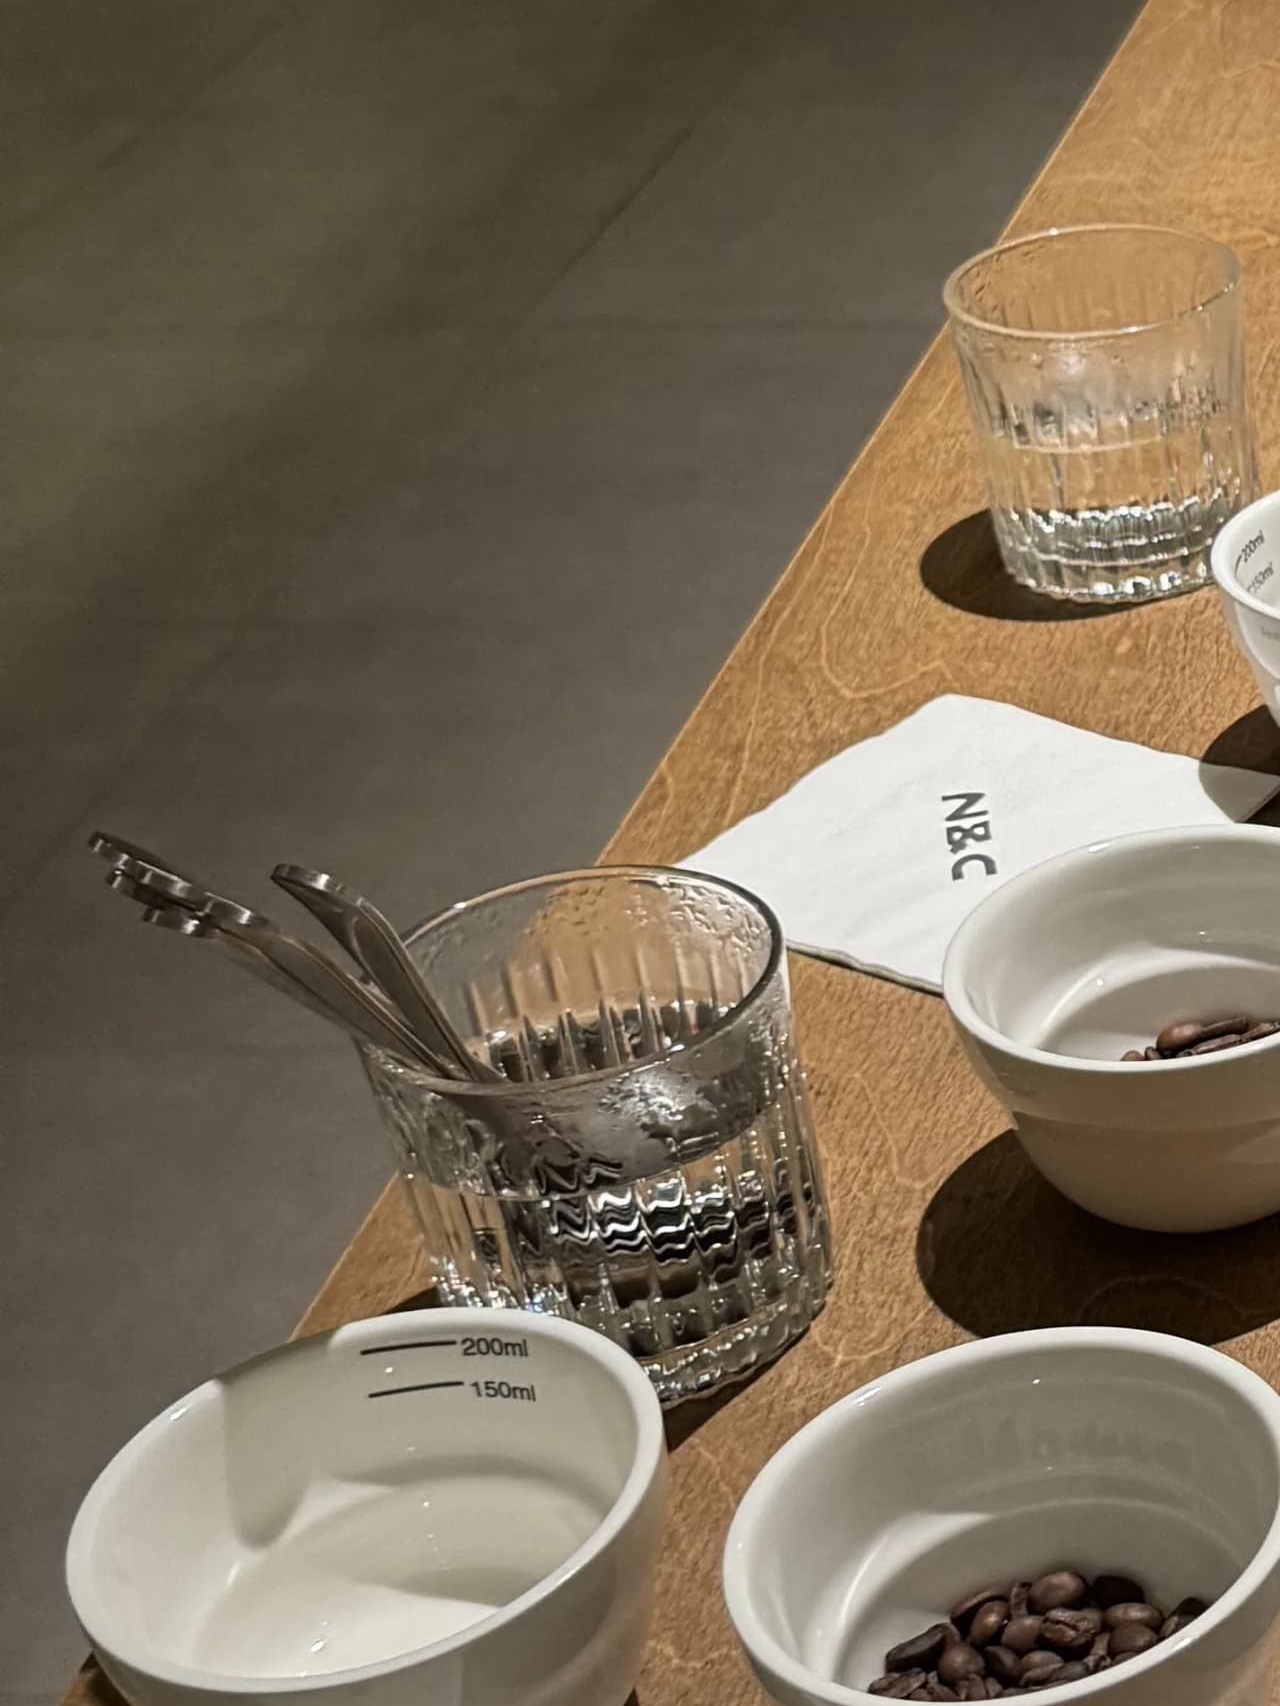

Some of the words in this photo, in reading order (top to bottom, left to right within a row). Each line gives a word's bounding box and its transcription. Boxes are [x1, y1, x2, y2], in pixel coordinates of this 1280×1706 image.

[941, 792, 997, 881] N&C
[461, 1338, 528, 1357] 200ml
[471, 1381, 536, 1402] 150ml
